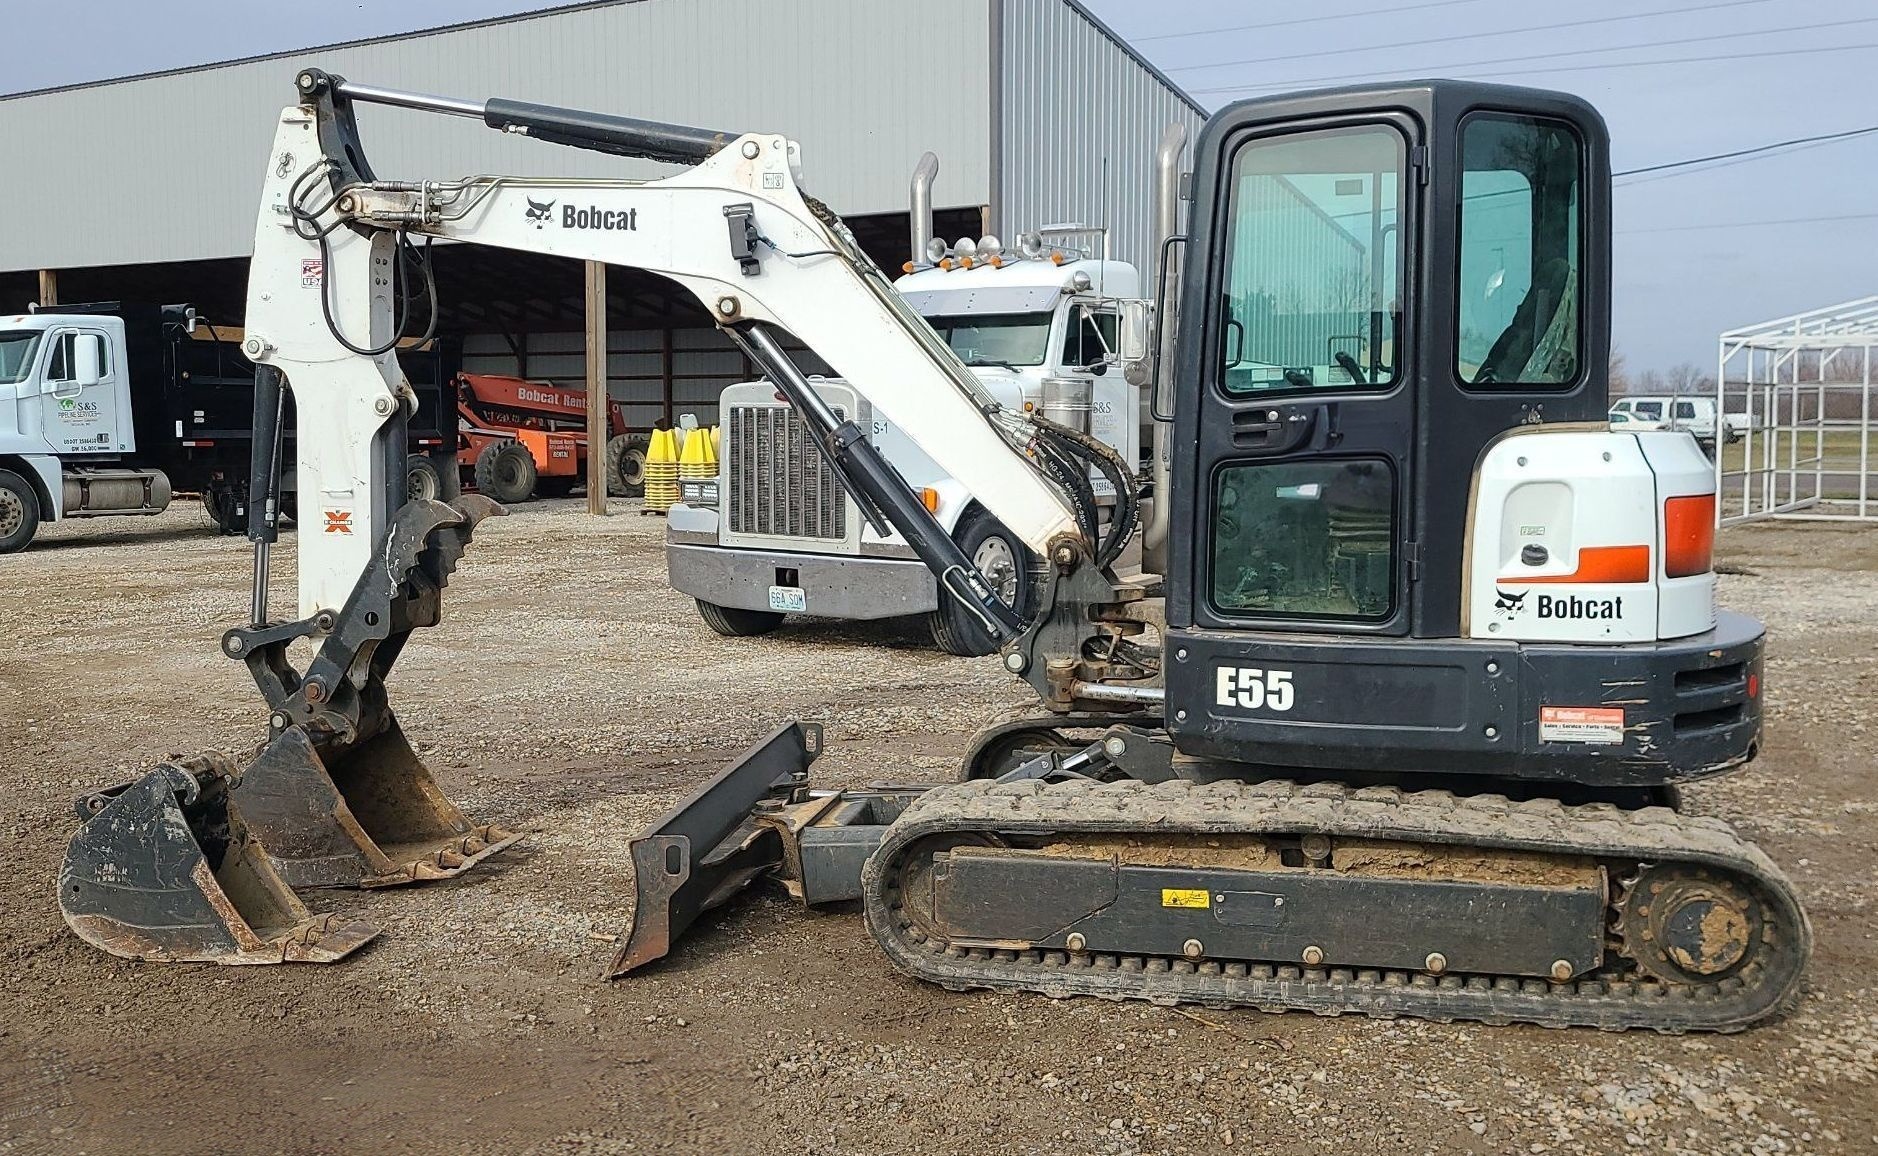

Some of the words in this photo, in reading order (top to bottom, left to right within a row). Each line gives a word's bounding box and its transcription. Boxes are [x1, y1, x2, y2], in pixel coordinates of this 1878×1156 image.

[562, 204, 637, 231] Bobcat
[518, 387, 559, 405] Bobcat
[77, 401, 97, 411] S&S
[1093, 401, 1112, 414] S&S
[873, 421, 888, 435] S-1
[1537, 594, 1622, 619] Bobcat
[1216, 666, 1295, 711] E55
